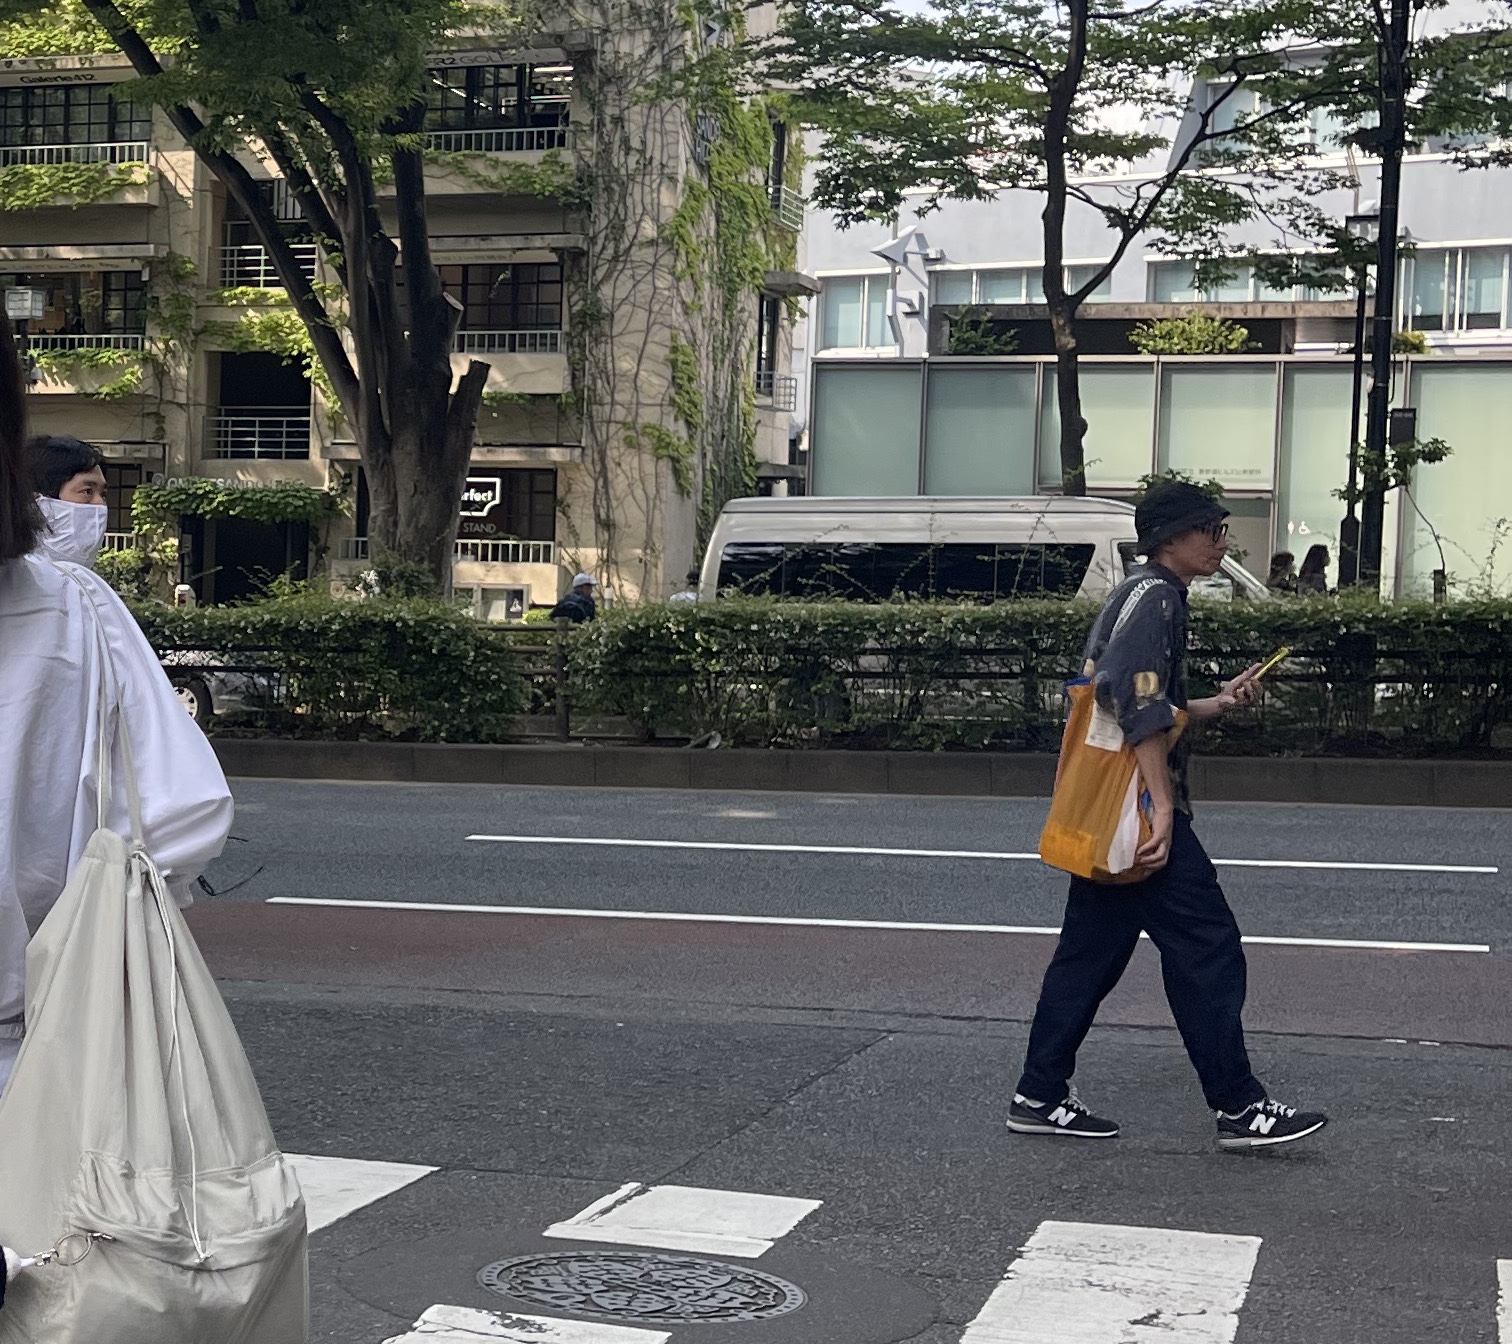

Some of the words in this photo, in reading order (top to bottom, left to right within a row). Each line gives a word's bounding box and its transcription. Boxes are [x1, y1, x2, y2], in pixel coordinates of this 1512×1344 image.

[461, 488, 493, 501] rfect
[463, 522, 497, 533] STAND
[1047, 1106, 1077, 1127] N
[1248, 1113, 1277, 1135] N
